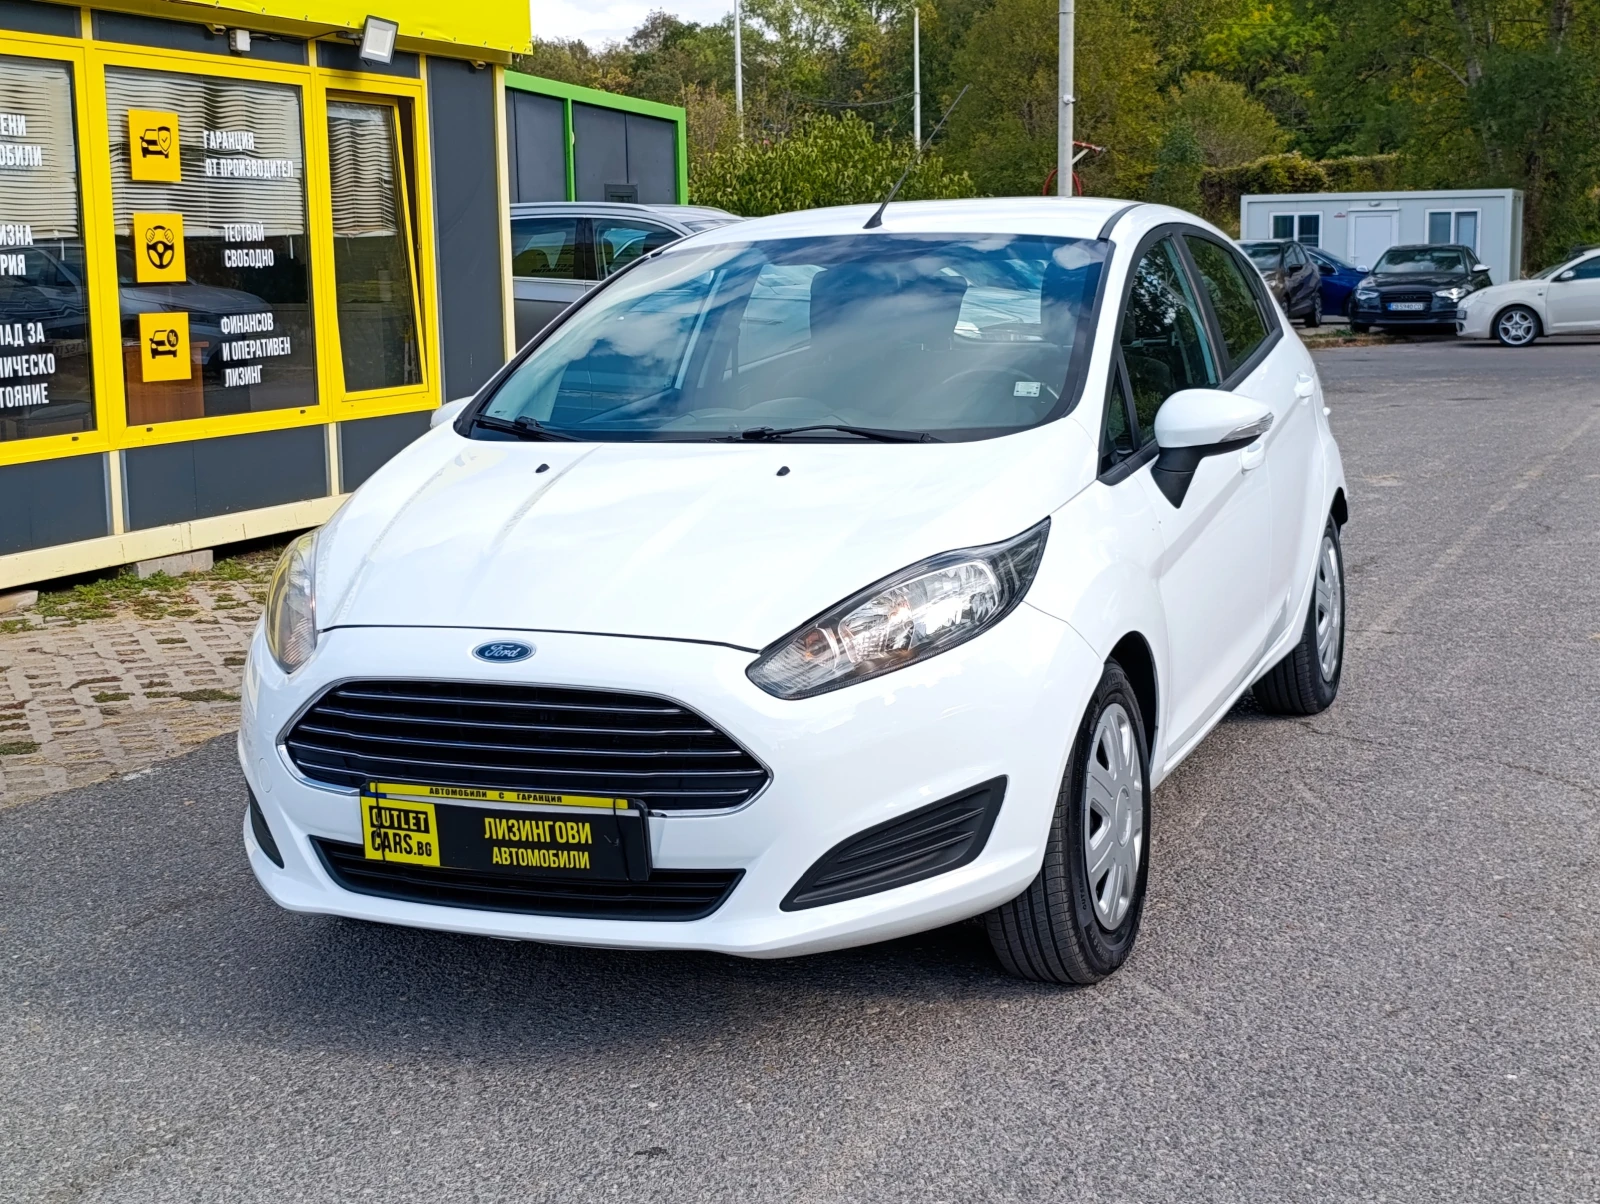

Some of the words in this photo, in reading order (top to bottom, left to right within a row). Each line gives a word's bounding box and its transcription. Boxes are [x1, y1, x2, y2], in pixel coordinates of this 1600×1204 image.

[0, 114, 27, 136] ЕНИ
[203, 130, 255, 151] ГАРАНЦИЯ
[205, 158, 219, 177] ОТ
[220, 159, 294, 179] ПРОИЗВОДИТЕЛ
[223, 221, 265, 242] ТЕСТВАЙ
[0, 254, 27, 276] РИЯ
[224, 248, 275, 269] СВОБОДНО
[27, 321, 46, 344] ЗА
[220, 312, 274, 335] ФИНАНСОВ
[222, 342, 230, 361] И
[232, 336, 291, 361] ОПЕРАТИВЕН
[224, 365, 263, 387] ЛИЗИНГ
[484, 644, 522, 657] Ford
[429, 787, 488, 798] АВТОМОБИЛИ
[516, 793, 563, 804] ГАРАНЦИЯ
[372, 808, 426, 831] OUTLET
[484, 817, 593, 845] ЛИЗИНГОВИ
[370, 829, 432, 857] CARS.BG
[492, 846, 591, 870] АВТОМОБИЛИ
